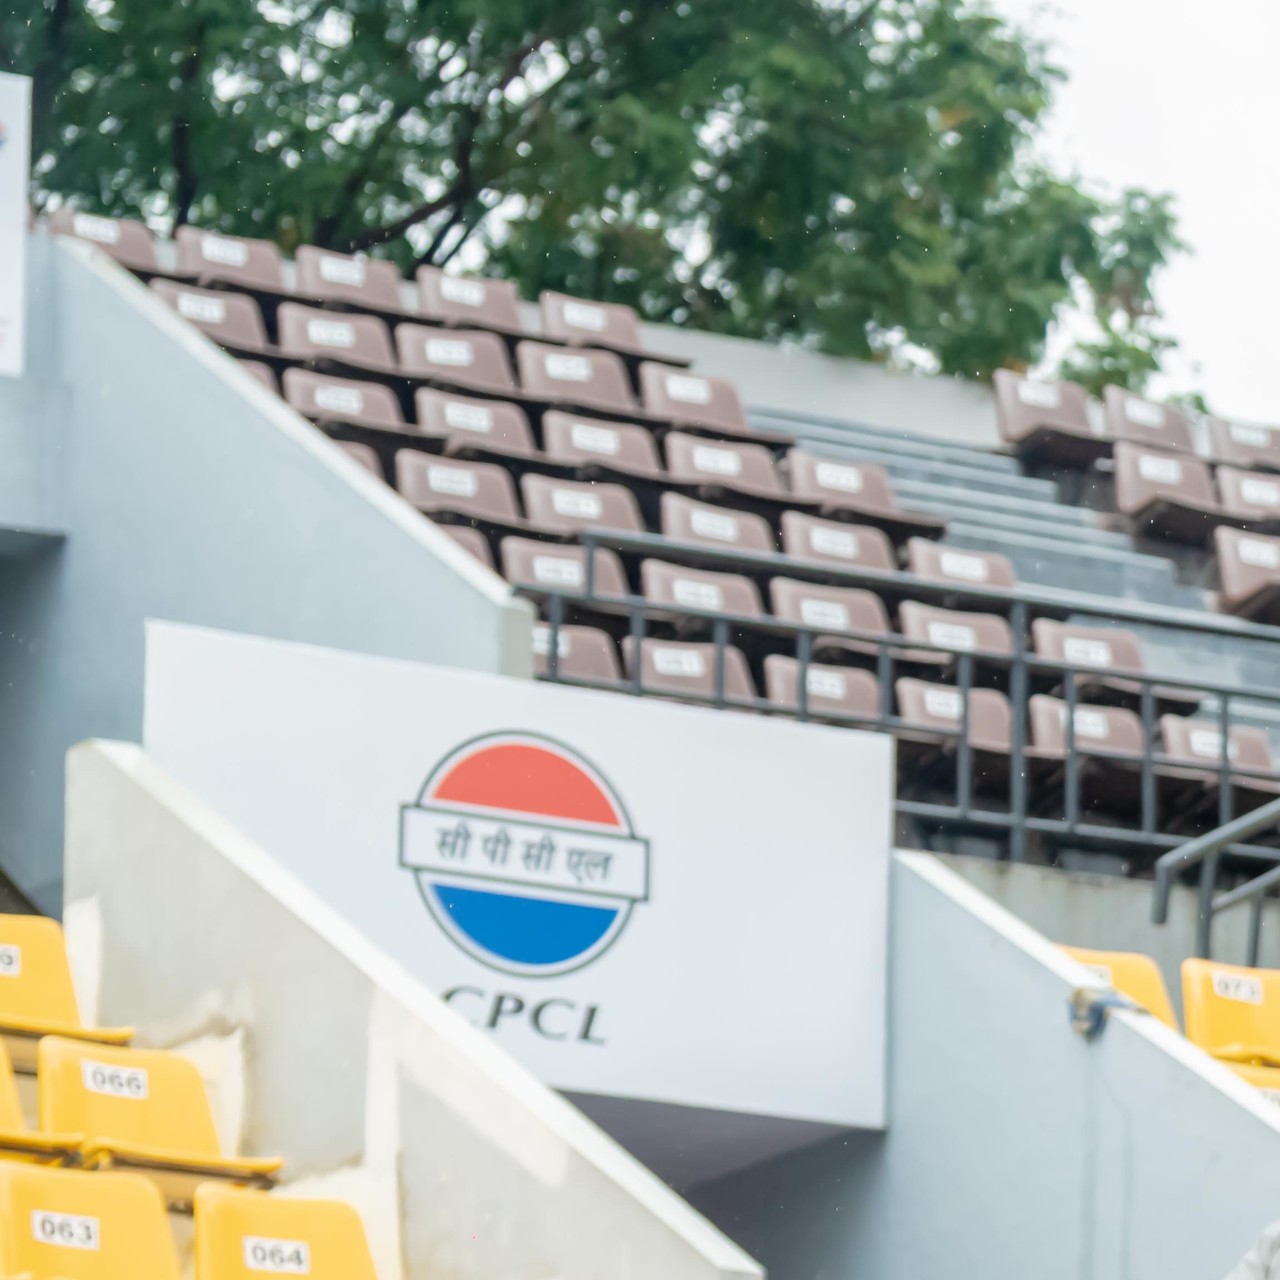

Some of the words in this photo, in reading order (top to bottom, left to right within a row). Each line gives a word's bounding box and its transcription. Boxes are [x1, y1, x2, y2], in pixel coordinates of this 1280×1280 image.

[436, 820, 471, 860] सी
[482, 828, 512, 866] पी
[521, 832, 556, 873] सी
[566, 848, 613, 883] एल
[92, 1067, 141, 1095] 066
[41, 1216, 92, 1243] 063
[252, 1245, 303, 1266] 064
